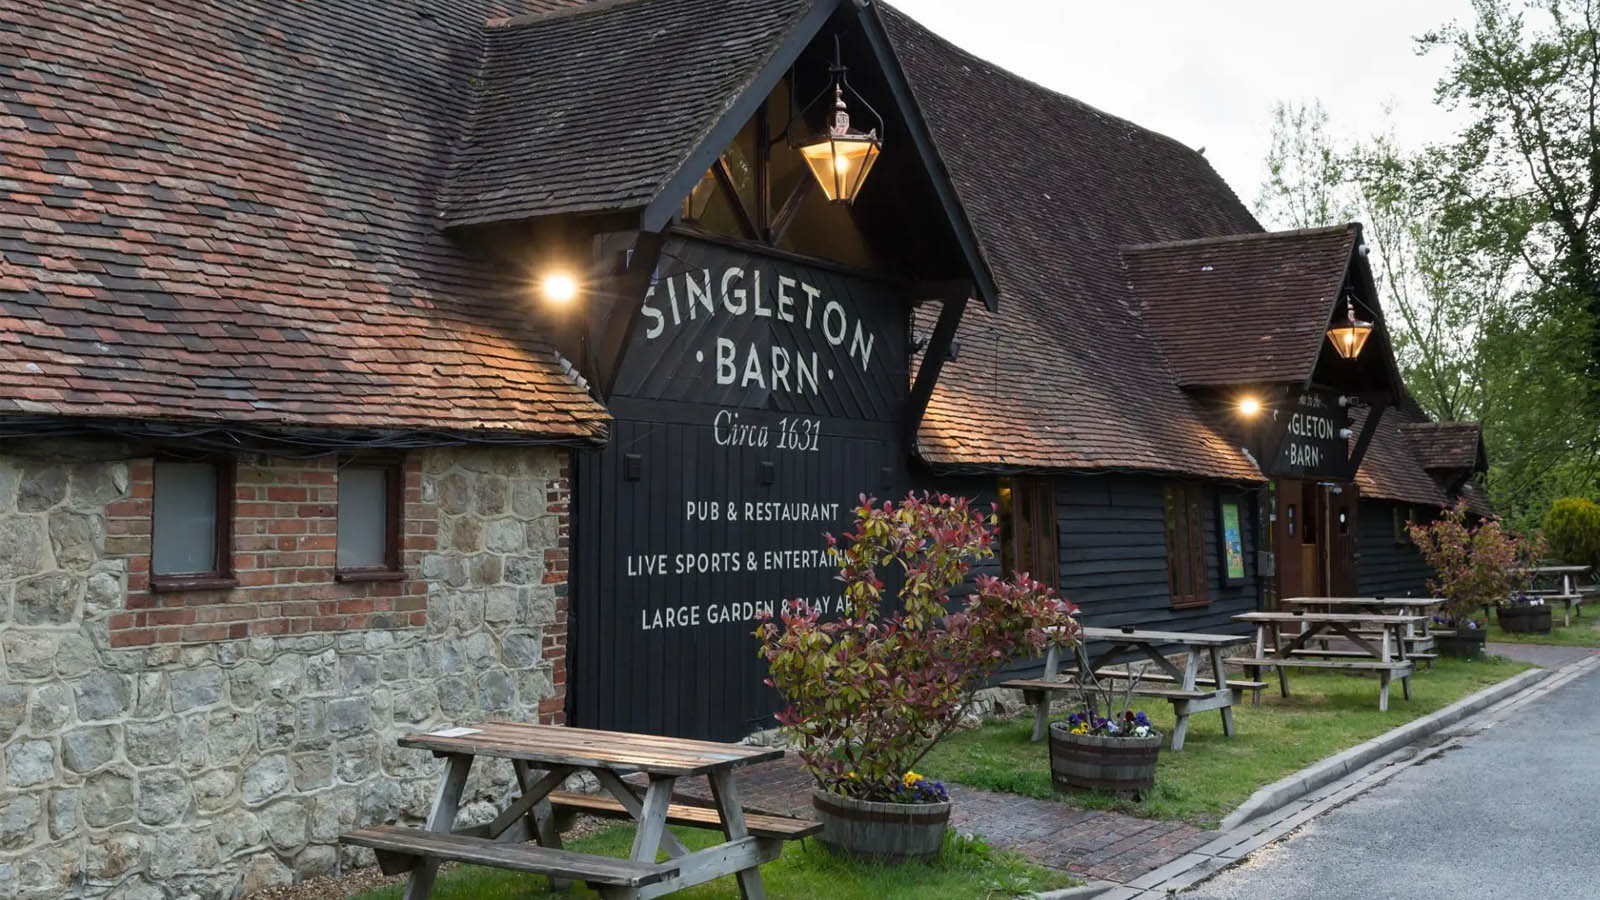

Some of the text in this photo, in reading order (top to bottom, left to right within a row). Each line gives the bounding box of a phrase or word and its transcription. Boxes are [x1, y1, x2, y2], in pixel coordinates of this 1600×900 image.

[641, 267, 875, 372] SINGLETON
[716, 337, 819, 396] BARN
[714, 409, 821, 451] Circa 1631
[1273, 409, 1333, 440] GLETON
[1290, 443, 1319, 467] BARN
[686, 501, 839, 521] PUB & RESTAURANT
[627, 554, 668, 577] LIVE
[675, 552, 741, 574] SPORTS
[746, 551, 758, 571] &
[642, 605, 700, 630] LARGE
[706, 599, 774, 624] GARDEN
[835, 594, 858, 614] AR
